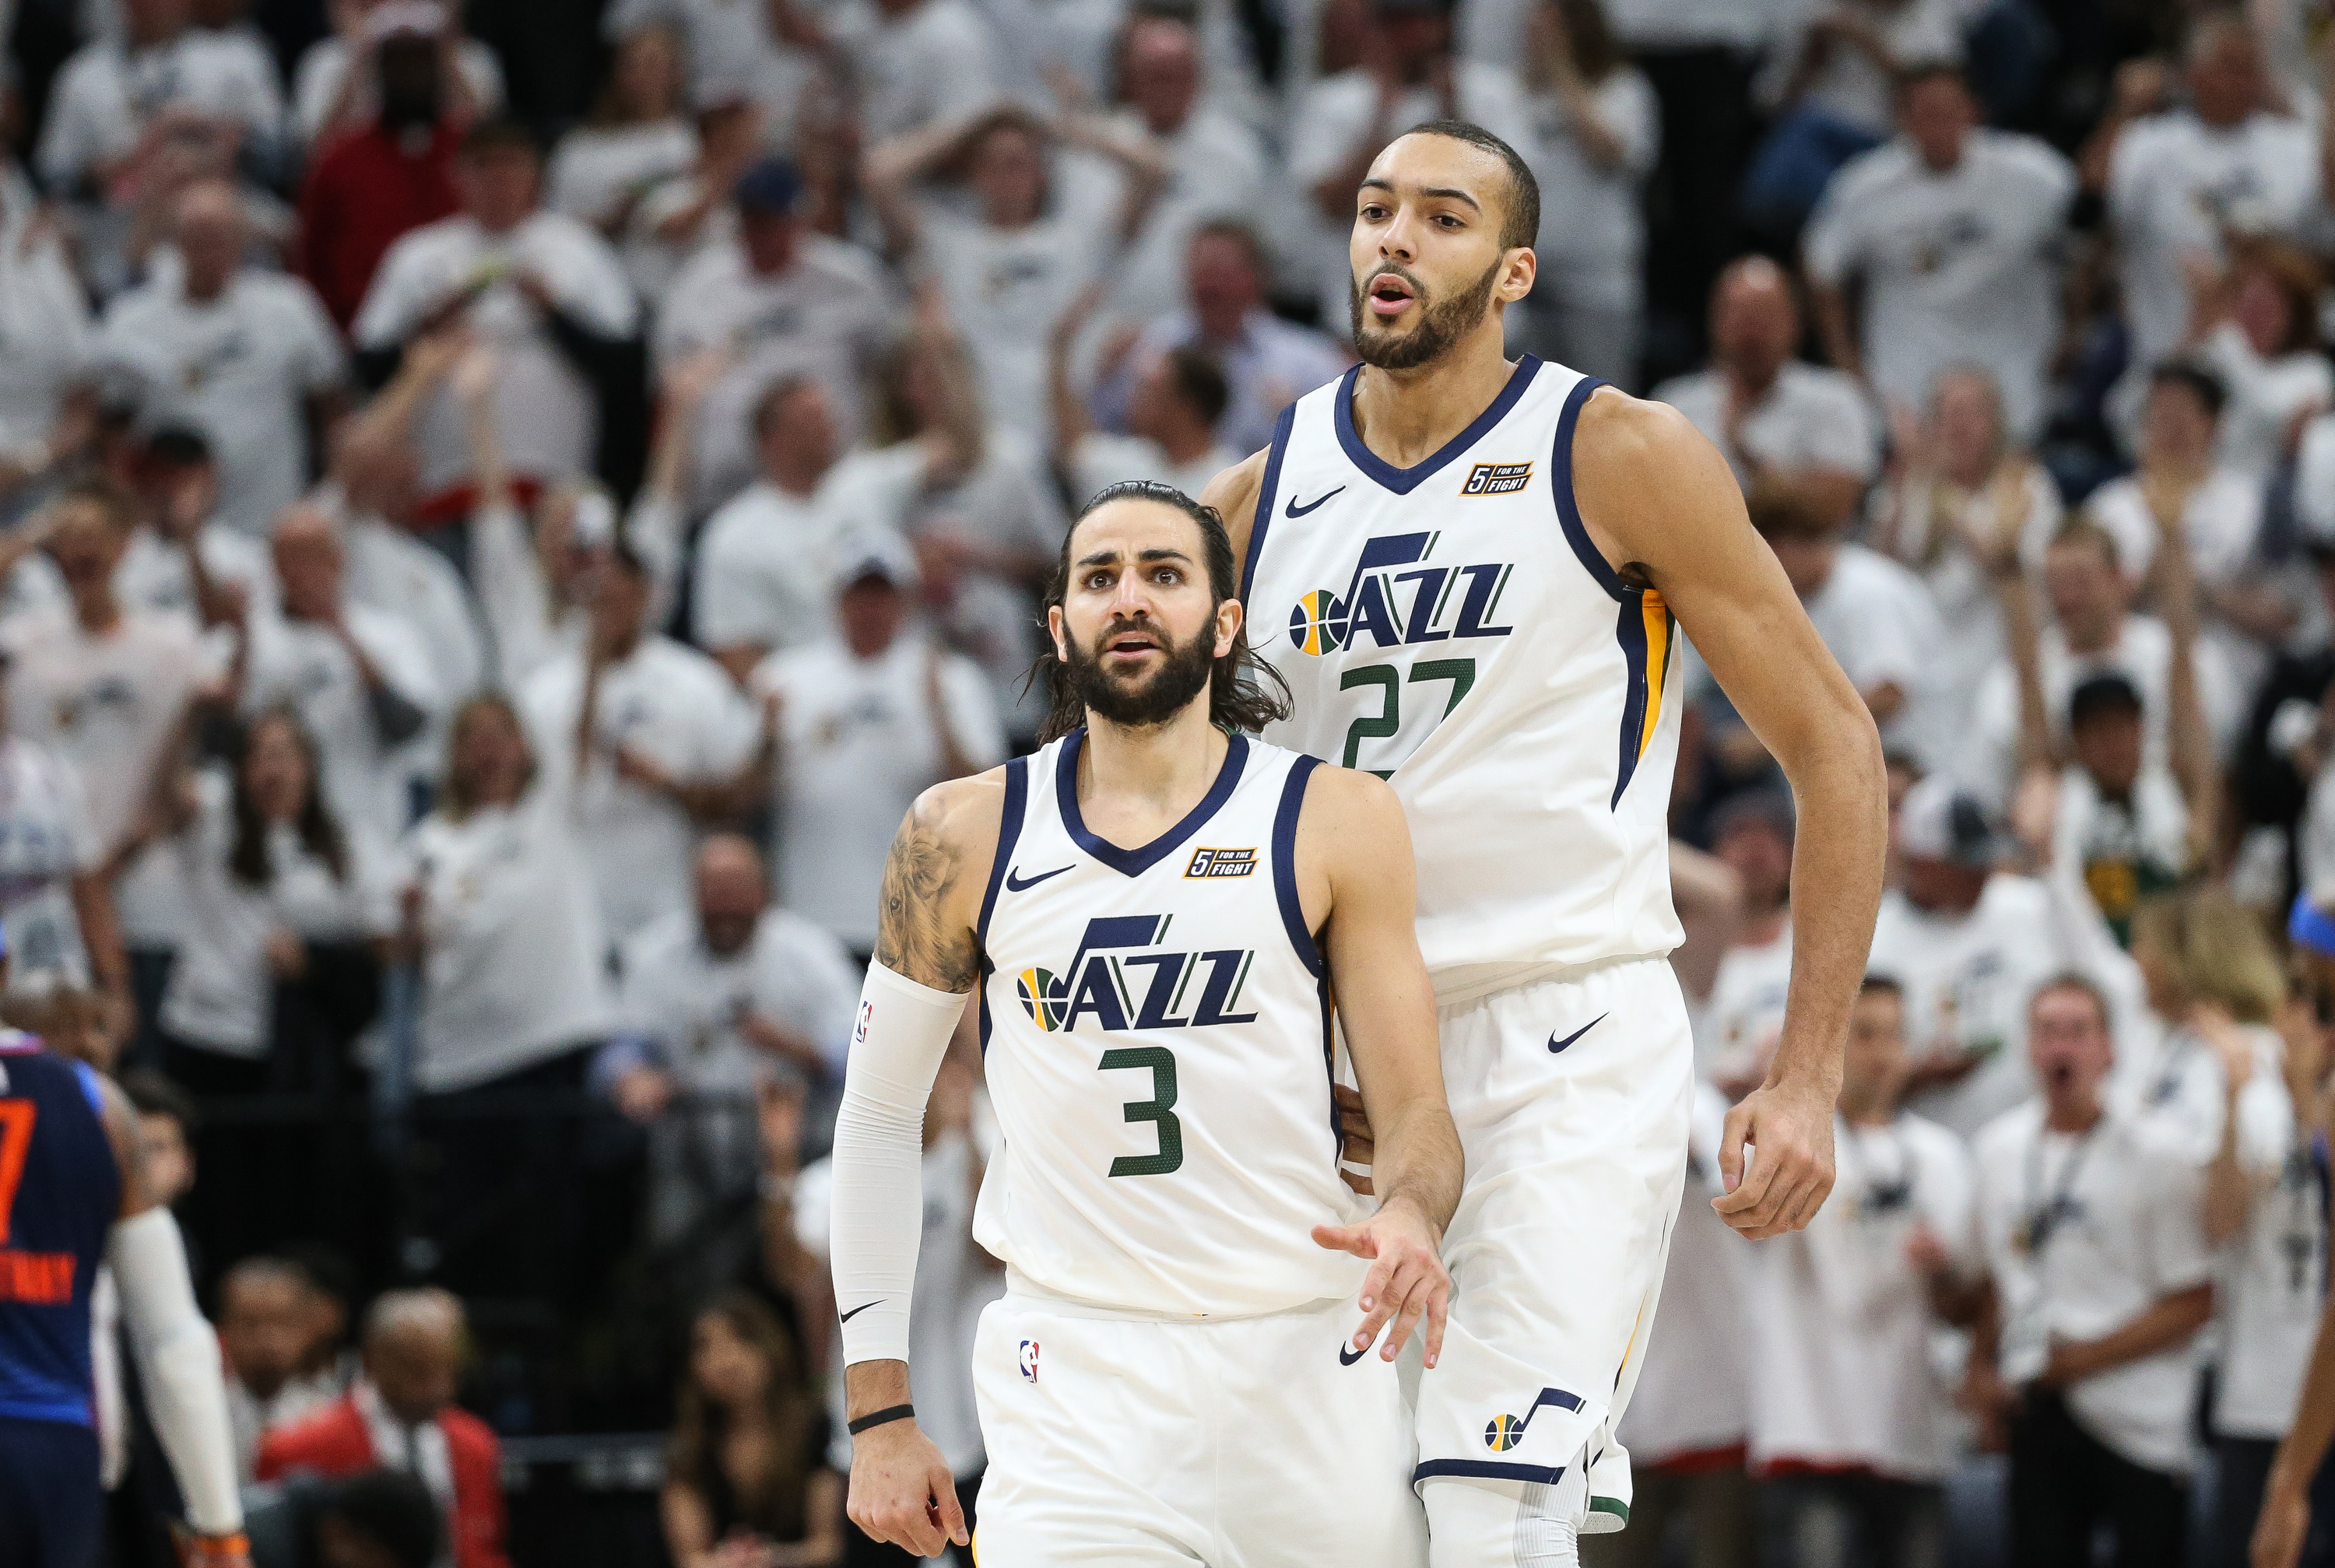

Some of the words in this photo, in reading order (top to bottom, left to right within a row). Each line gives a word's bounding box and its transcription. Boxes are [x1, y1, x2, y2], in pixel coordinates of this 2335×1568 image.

[1467, 467, 1491, 493] 5
[1496, 467, 1512, 475] FOR
[1512, 465, 1527, 475] THE
[1487, 477, 1527, 492] FIGHT
[1289, 531, 1515, 657] JAZZ
[1339, 658, 1476, 780] 27
[1190, 851, 1213, 875] 5
[1211, 862, 1252, 875] FIGHT
[1017, 914, 1259, 1033] JAZZ
[1097, 1046, 1184, 1177] 3
